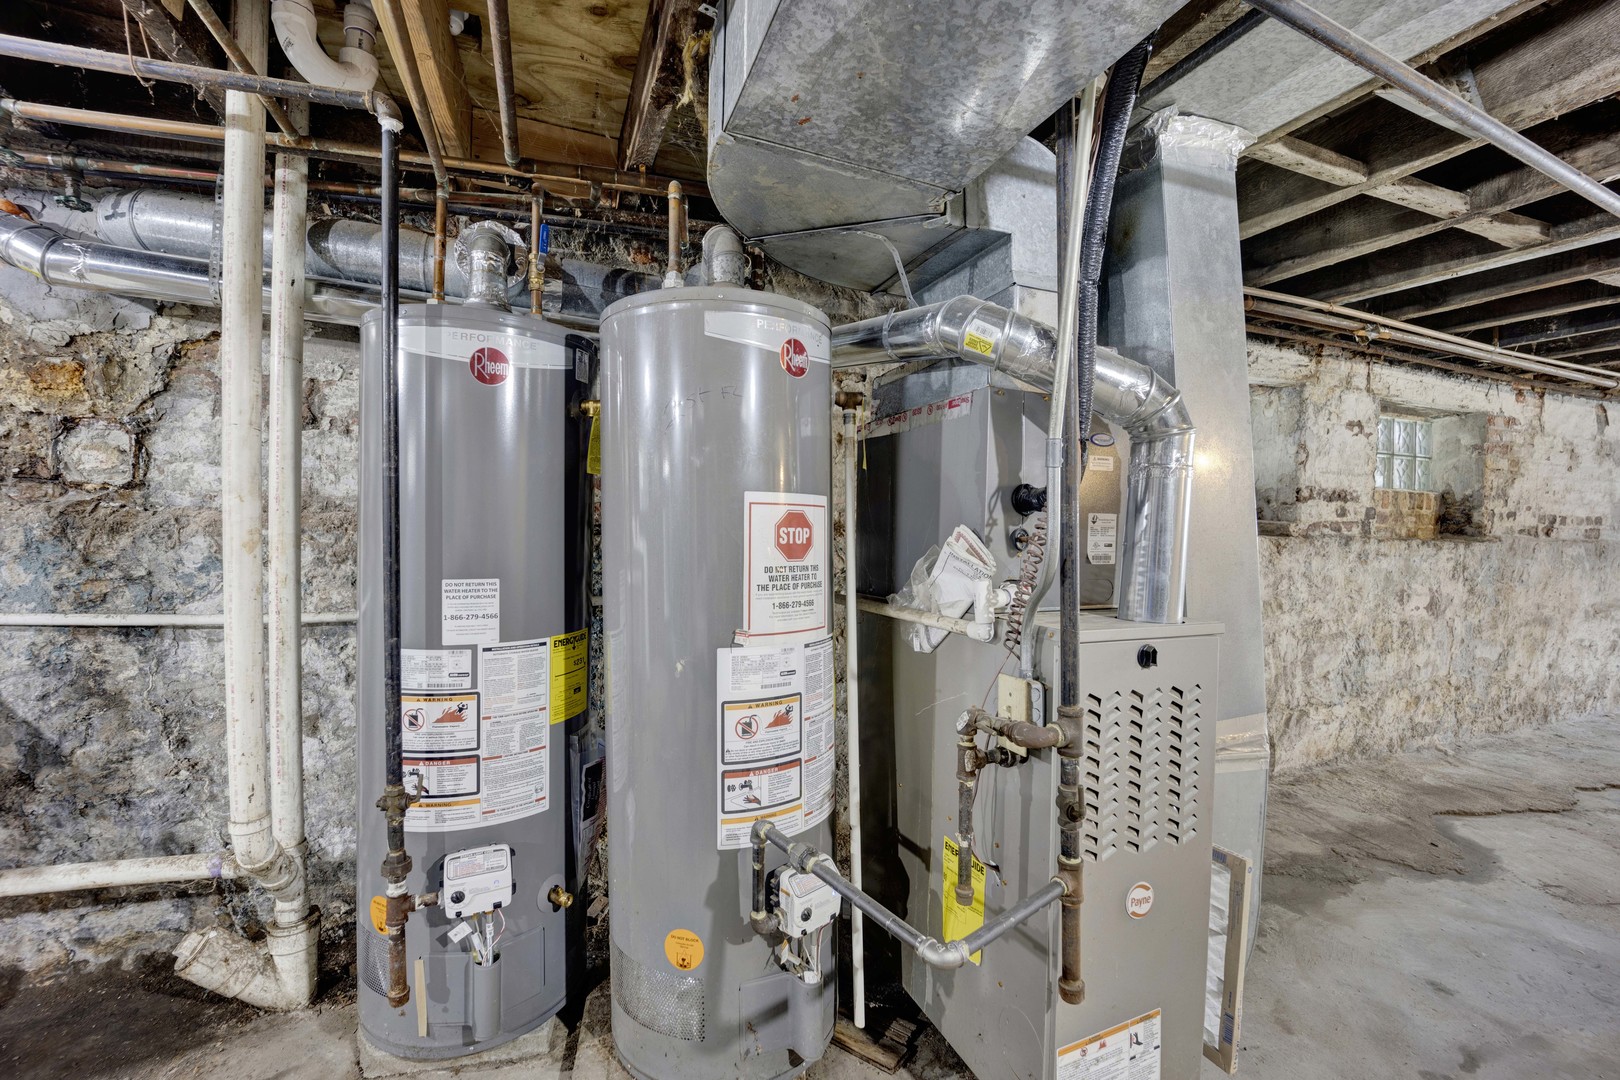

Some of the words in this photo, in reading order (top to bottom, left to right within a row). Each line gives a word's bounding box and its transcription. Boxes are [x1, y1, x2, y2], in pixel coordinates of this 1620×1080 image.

[475, 347, 509, 379] Rheem
[779, 527, 810, 545] STOP
[764, 566, 774, 574] DO
[775, 565, 787, 573] NOT
[788, 564, 810, 573] RETURN
[768, 574, 790, 583] WATER
[790, 573, 811, 582] HEATER
[756, 584, 770, 592] THE
[771, 583, 791, 592] PLACE
[792, 582, 799, 590] OF
[772, 599, 815, 610] 1-866-279-4566
[443, 612, 499, 621] 1-866-279-4566
[755, 699, 783, 708] WARNING
[755, 766, 779, 776] DANGER
[1130, 895, 1152, 908] Payne
